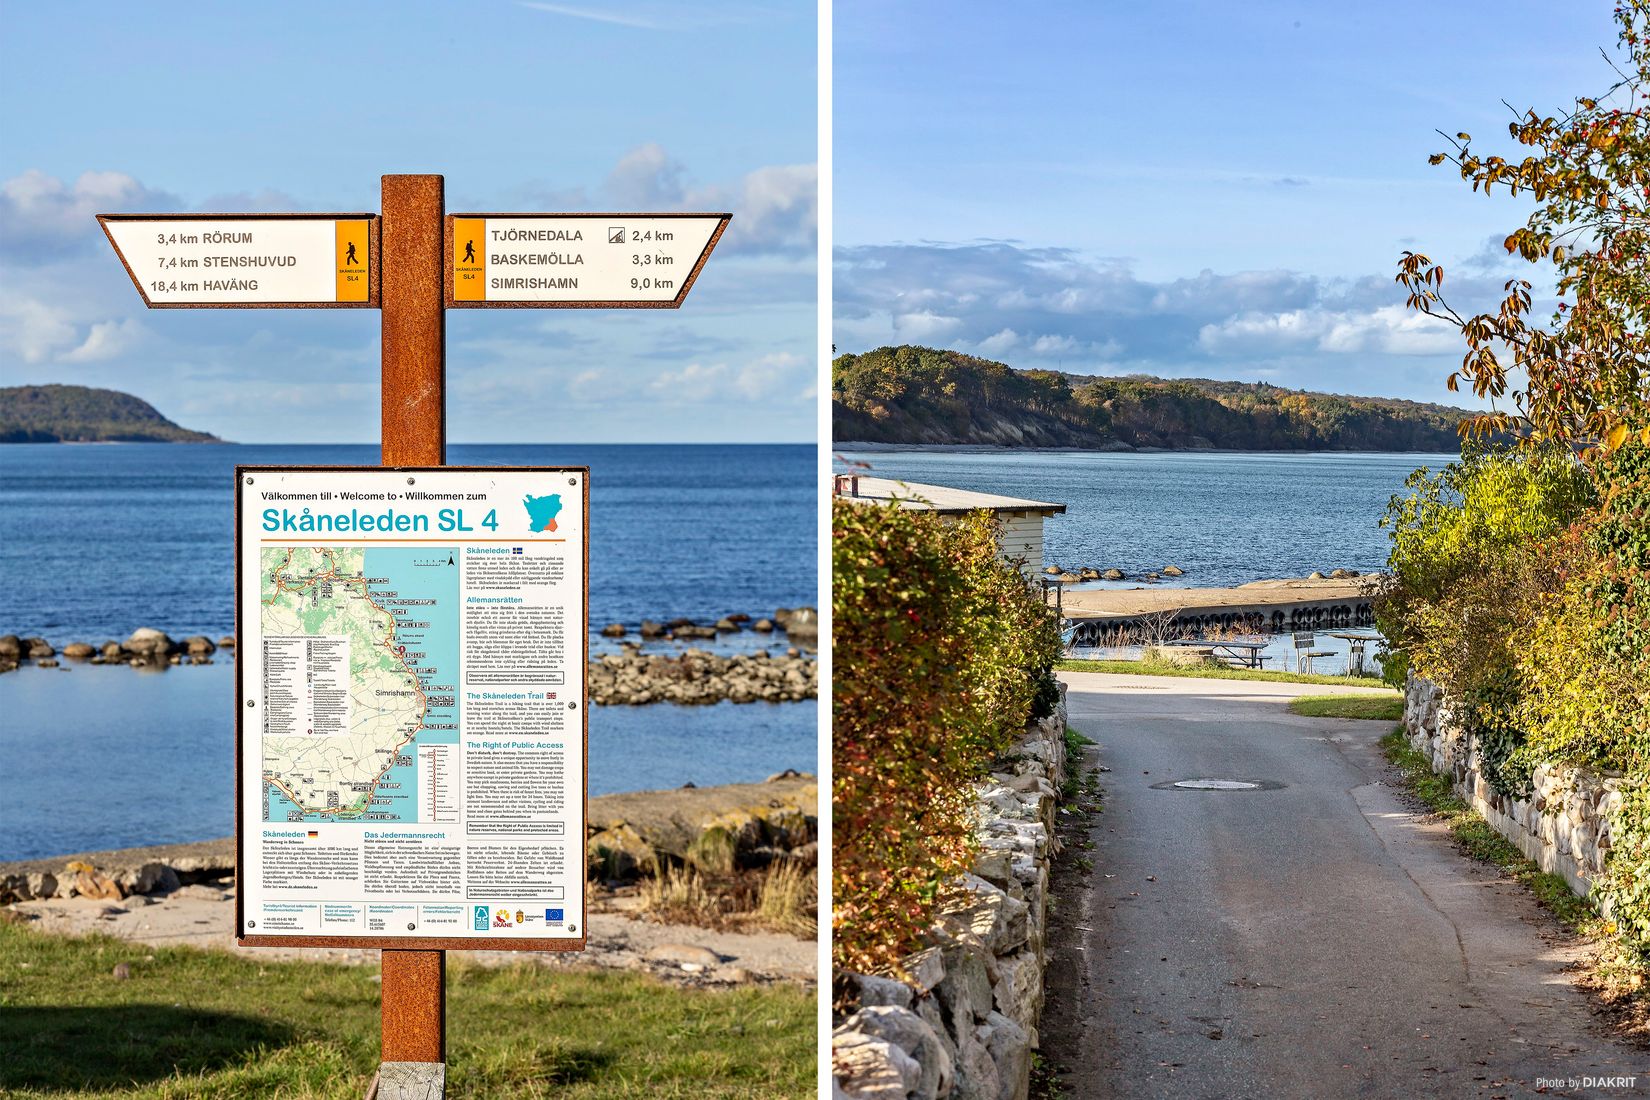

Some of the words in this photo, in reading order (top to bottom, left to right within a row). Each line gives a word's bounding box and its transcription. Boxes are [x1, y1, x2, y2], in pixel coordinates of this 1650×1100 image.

[158, 234, 176, 246] 3,4
[180, 234, 198, 244] km
[203, 231, 252, 243] RÖRUM
[492, 228, 583, 241] TJÖRNEDALA
[633, 231, 651, 242] 2,4
[656, 231, 673, 240] km
[158, 258, 177, 269] 7,4
[181, 258, 198, 267] km
[204, 256, 296, 267] STENSHUVUD
[492, 252, 584, 264] BASKEMÖLLA
[632, 255, 651, 266] 3,3
[655, 255, 673, 264] km
[151, 281, 177, 293] 18,4
[181, 281, 198, 291] km
[204, 278, 258, 290] HAVÄNG
[492, 278, 578, 288] SIMRISHAMN
[631, 278, 650, 290] 9,0
[655, 278, 673, 288] km
[320, 492, 331, 500] till
[340, 492, 384, 500] Welcome
[387, 492, 397, 500] to
[405, 492, 464, 500] Willkommen
[263, 508, 428, 531] Skåneleden
[438, 509, 473, 531] SL
[482, 509, 499, 531] 4
